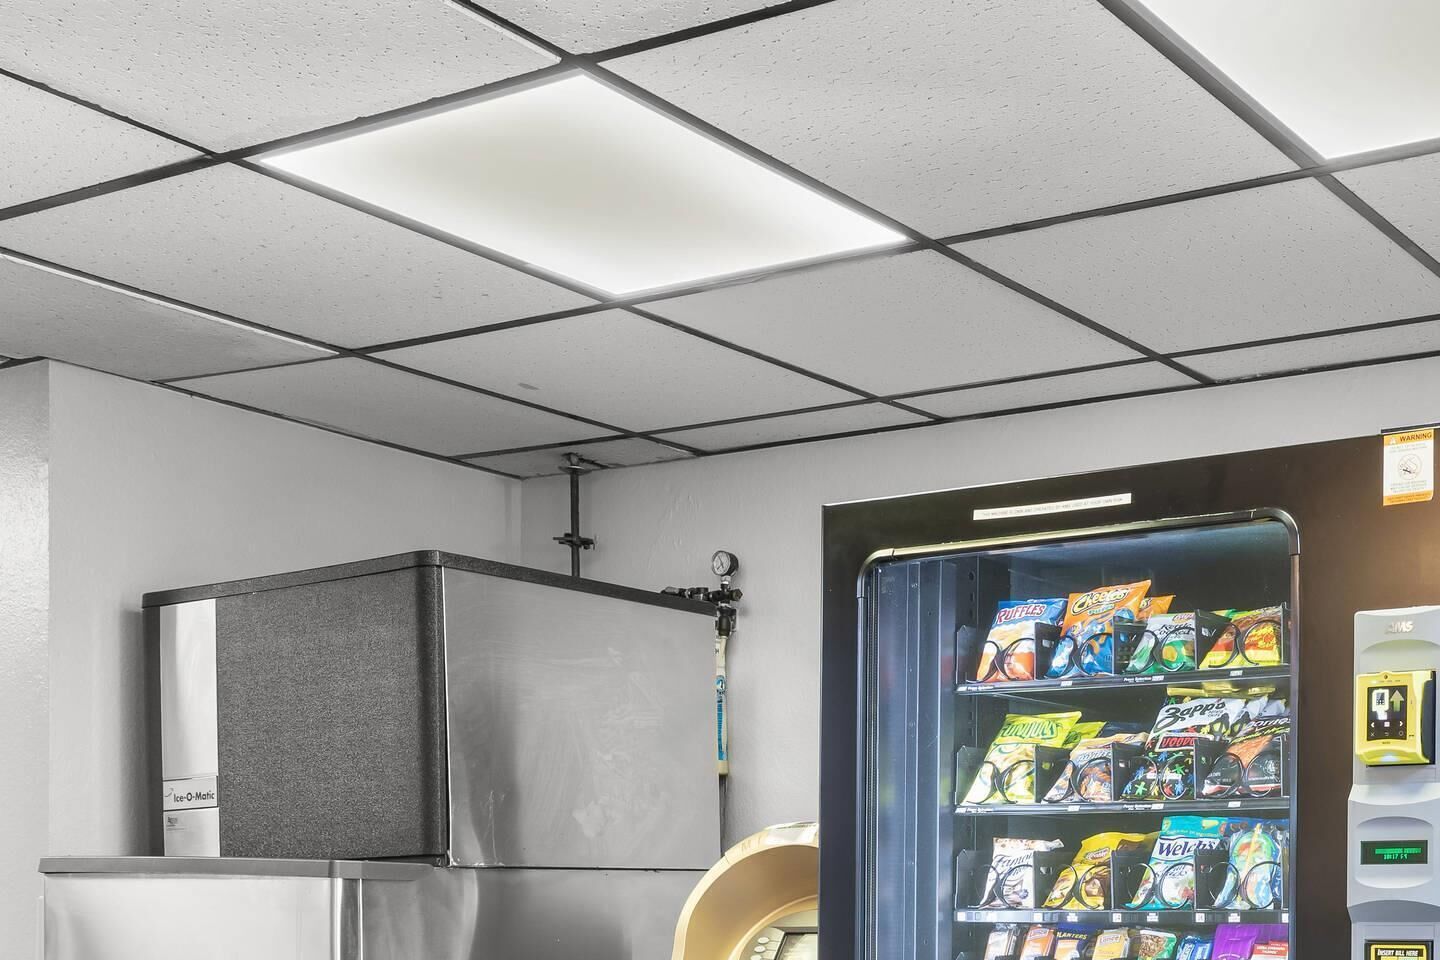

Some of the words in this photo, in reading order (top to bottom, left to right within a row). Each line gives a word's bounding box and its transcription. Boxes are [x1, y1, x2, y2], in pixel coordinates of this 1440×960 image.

[1400, 432, 1432, 442] WARNING
[1071, 587, 1131, 615] Cheetos
[997, 603, 1047, 624] RUFFLES
[173, 790, 216, 803] Ice-O-Matic
